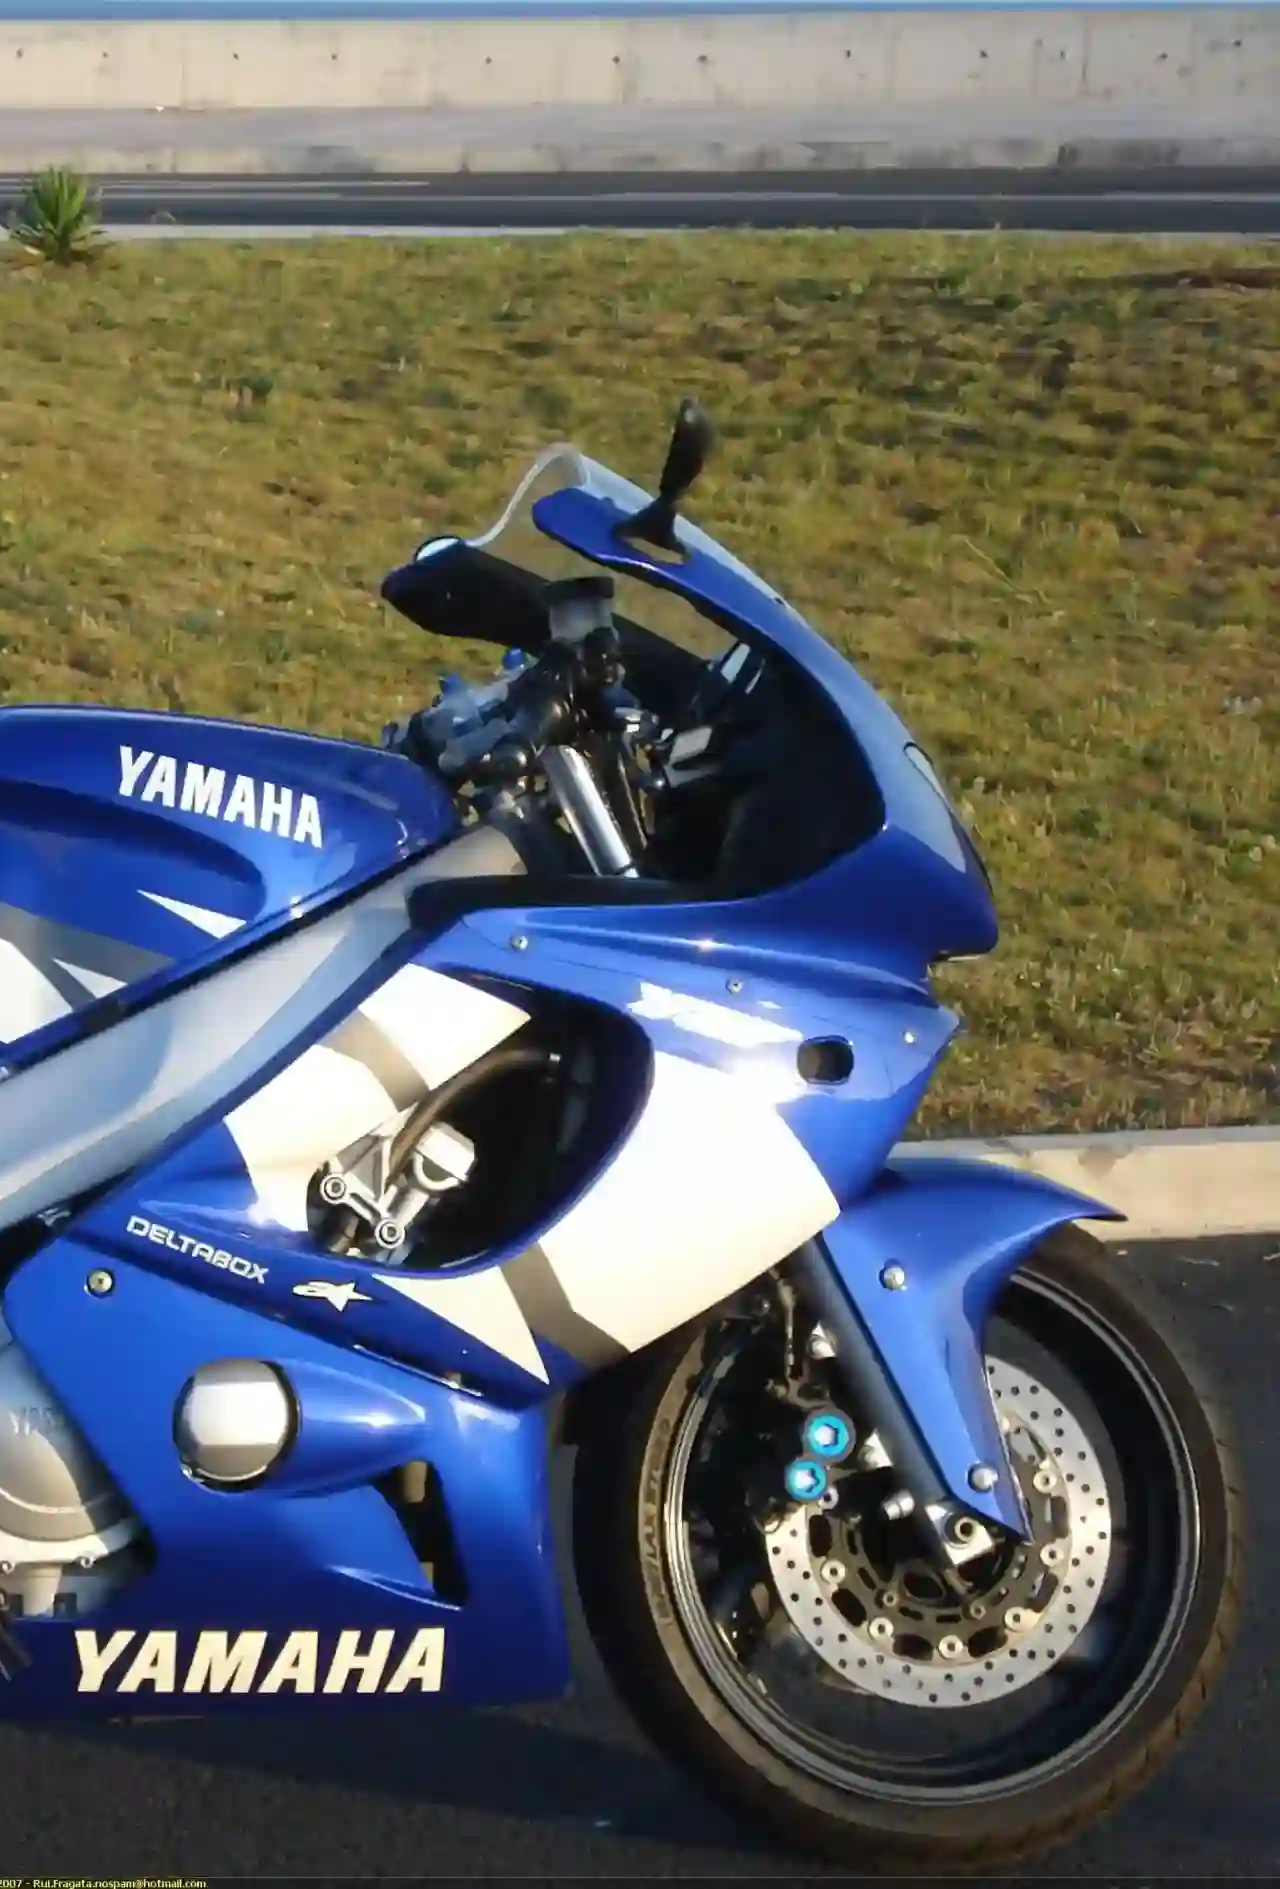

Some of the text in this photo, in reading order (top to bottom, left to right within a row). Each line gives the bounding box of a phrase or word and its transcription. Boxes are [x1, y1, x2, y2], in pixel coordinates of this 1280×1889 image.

[119, 745, 322, 848] YAMAHA
[126, 1215, 269, 1284] DELTABOX
[74, 1627, 445, 1694] YAMAHA
